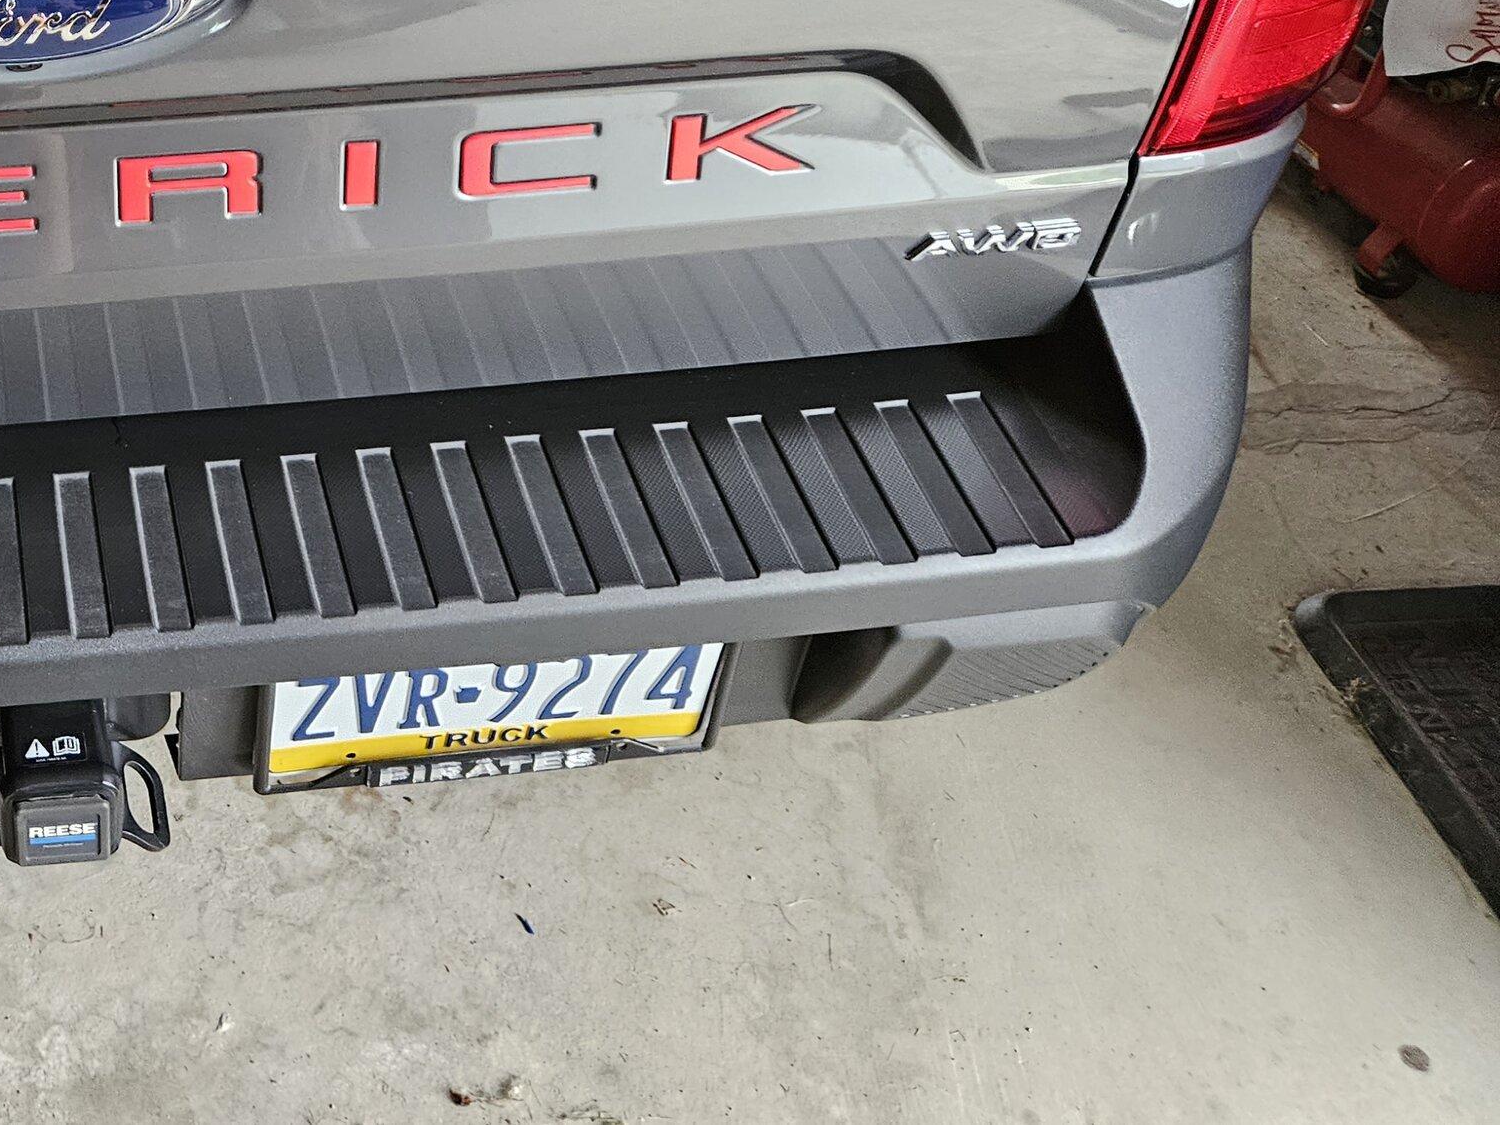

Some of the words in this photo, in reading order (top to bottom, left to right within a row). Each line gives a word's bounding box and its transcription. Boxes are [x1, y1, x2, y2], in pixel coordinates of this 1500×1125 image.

[904, 217, 1082, 261] AWD
[420, 724, 550, 750] TRUCK
[379, 747, 598, 787] PIRATES
[29, 823, 97, 838] REESE
